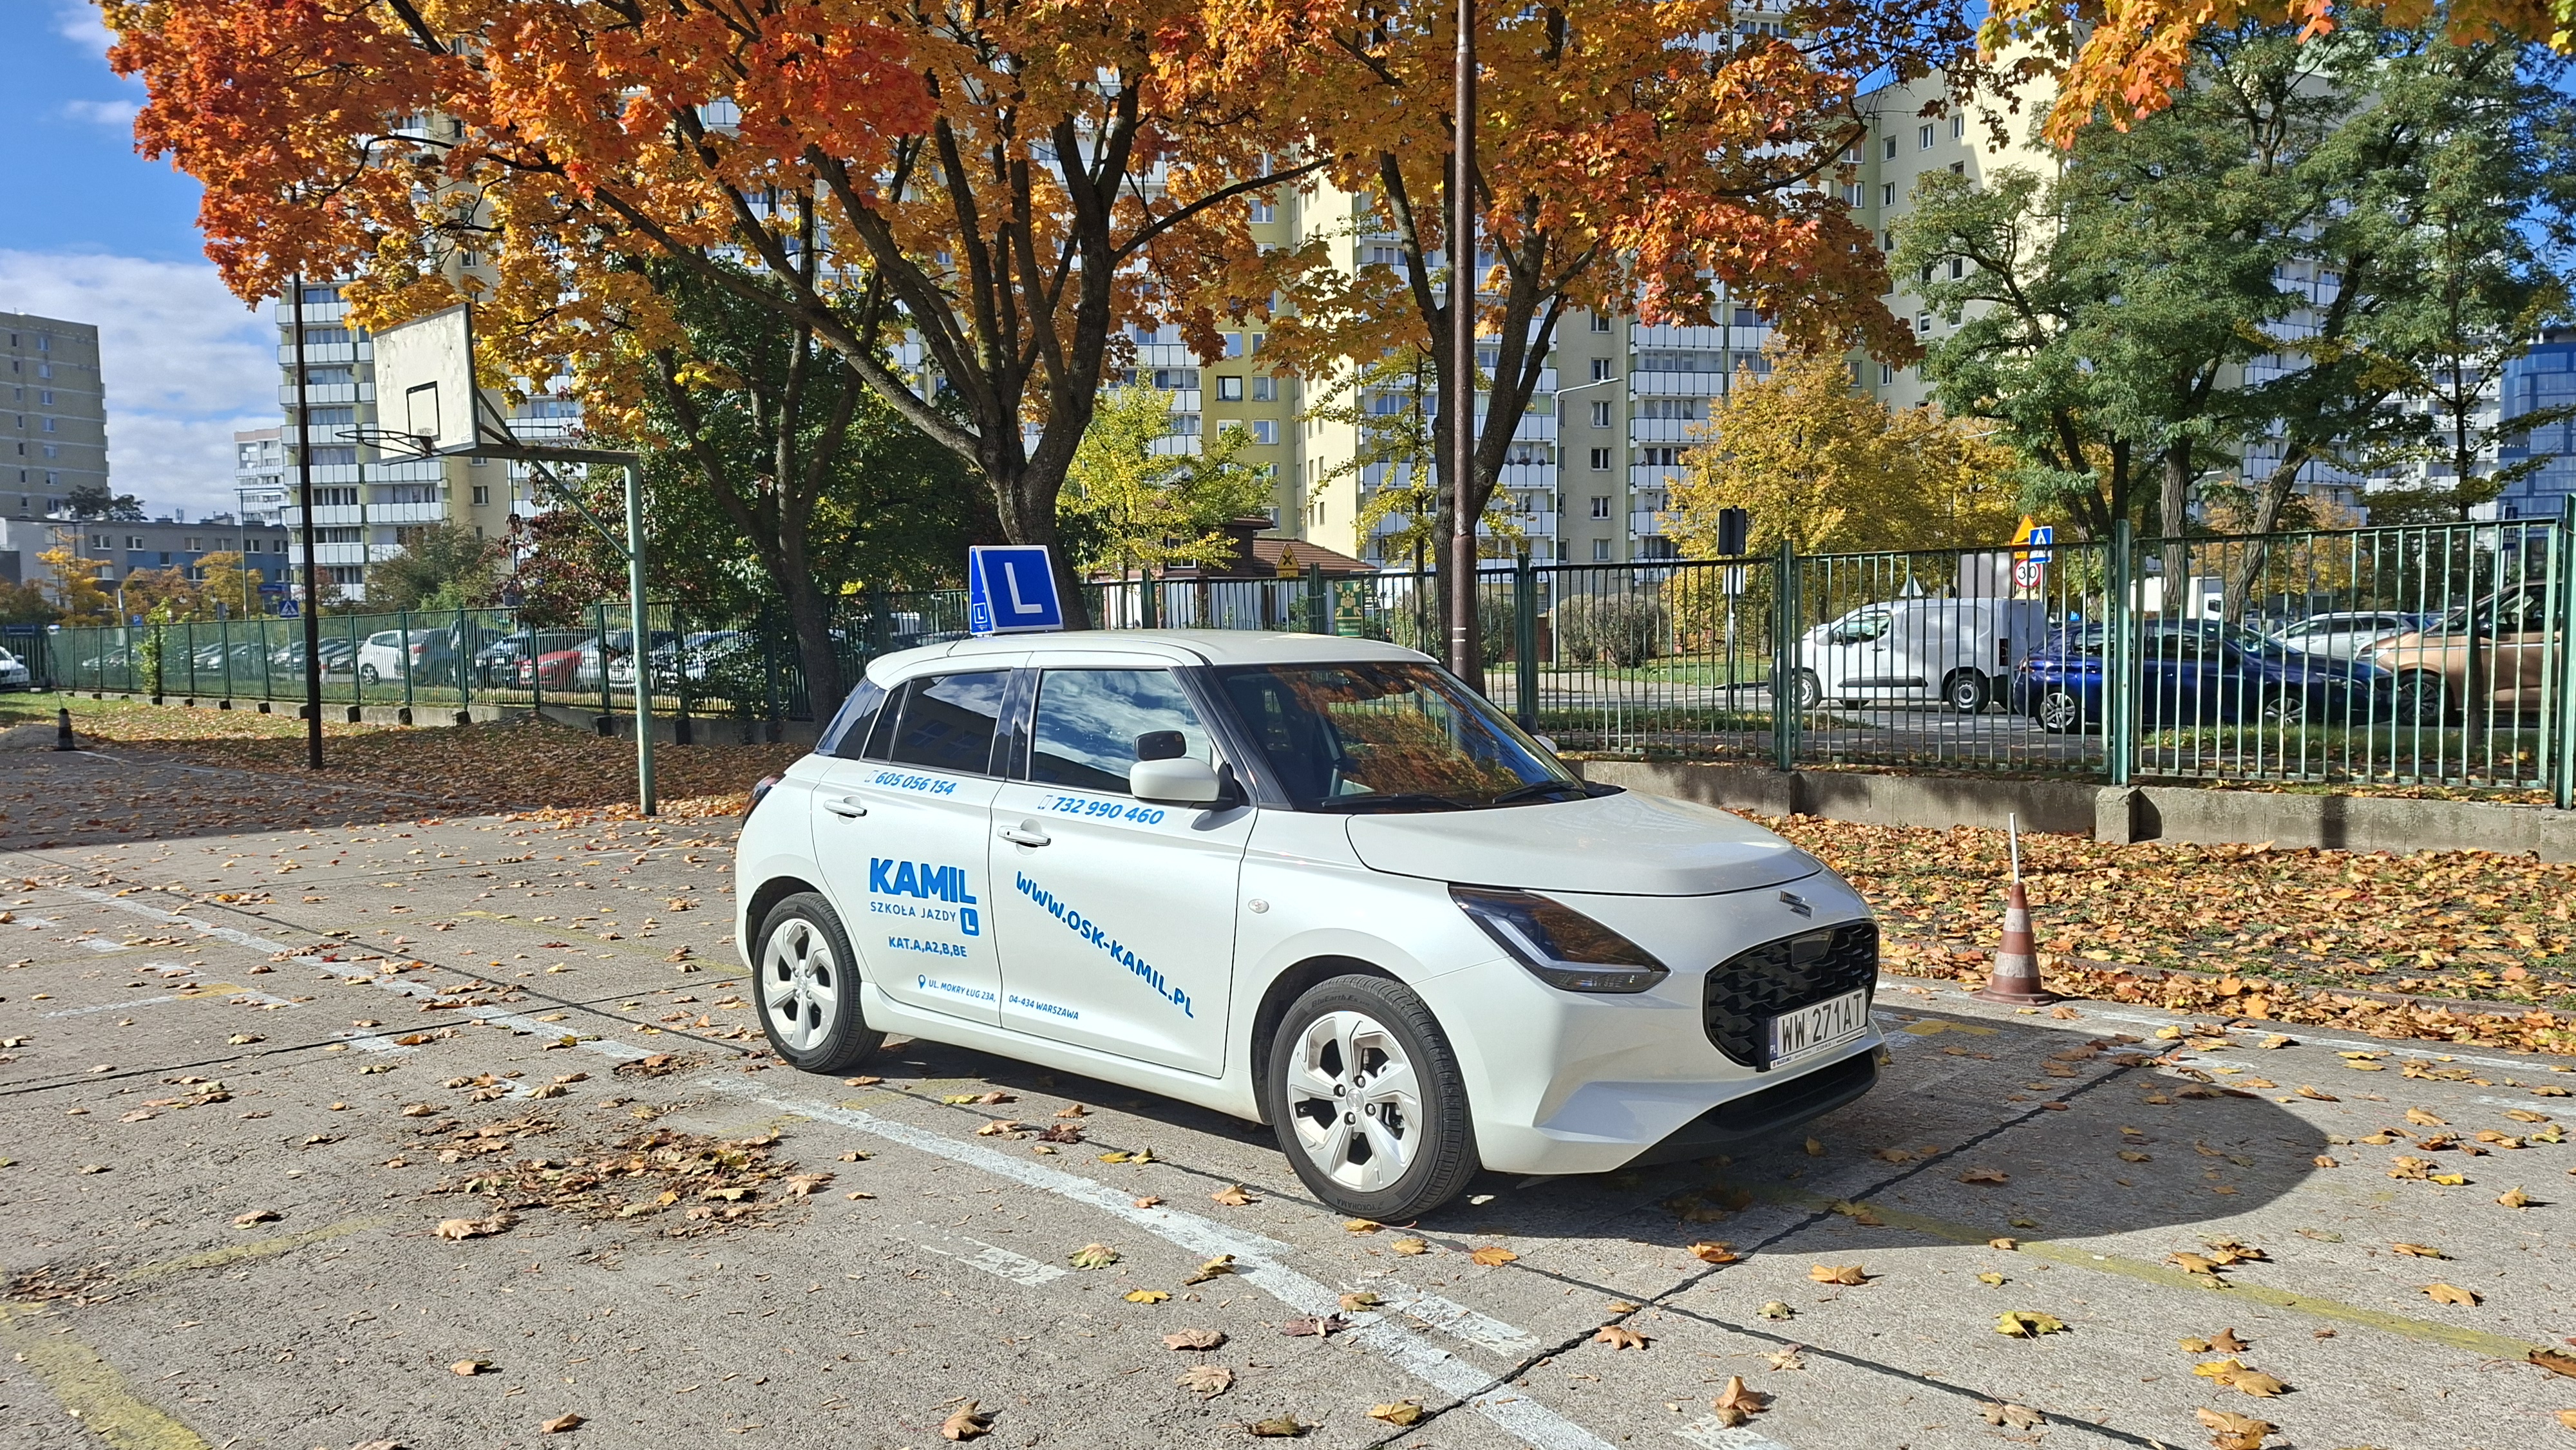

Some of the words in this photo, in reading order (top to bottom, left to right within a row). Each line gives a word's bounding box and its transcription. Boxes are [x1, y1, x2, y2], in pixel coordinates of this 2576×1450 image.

[2018, 566, 2037, 580] 30
[1005, 562, 1043, 614] L
[977, 607, 984, 619] L
[875, 771, 905, 786] 605
[901, 775, 932, 791] 056
[929, 780, 957, 795] 154
[1052, 796, 1086, 813] 732
[1084, 801, 1124, 819] 990
[1124, 807, 1165, 825] 460
[869, 857, 977, 905] KAMIL
[870, 901, 916, 918] SZKOŁA
[920, 907, 956, 923] JAZDY
[888, 936, 968, 957] KAT.A,A2,B,BE
[1016, 871, 1194, 1019] WWW.OSK-KAMIL.PL
[929, 979, 939, 989] UL.
[940, 982, 966, 995] MOKRY
[965, 989, 980, 998] ŁUG
[981, 991, 996, 1003] 23A,
[1009, 994, 1034, 1008] 04-434
[1036, 1001, 1079, 1020] WARSZAWA
[1770, 1044, 1777, 1055] PL
[1782, 1012, 1805, 1054] WW
[1812, 992, 1862, 1043] 271AT
[1336, 1197, 1377, 1211] YOKOHAMA
